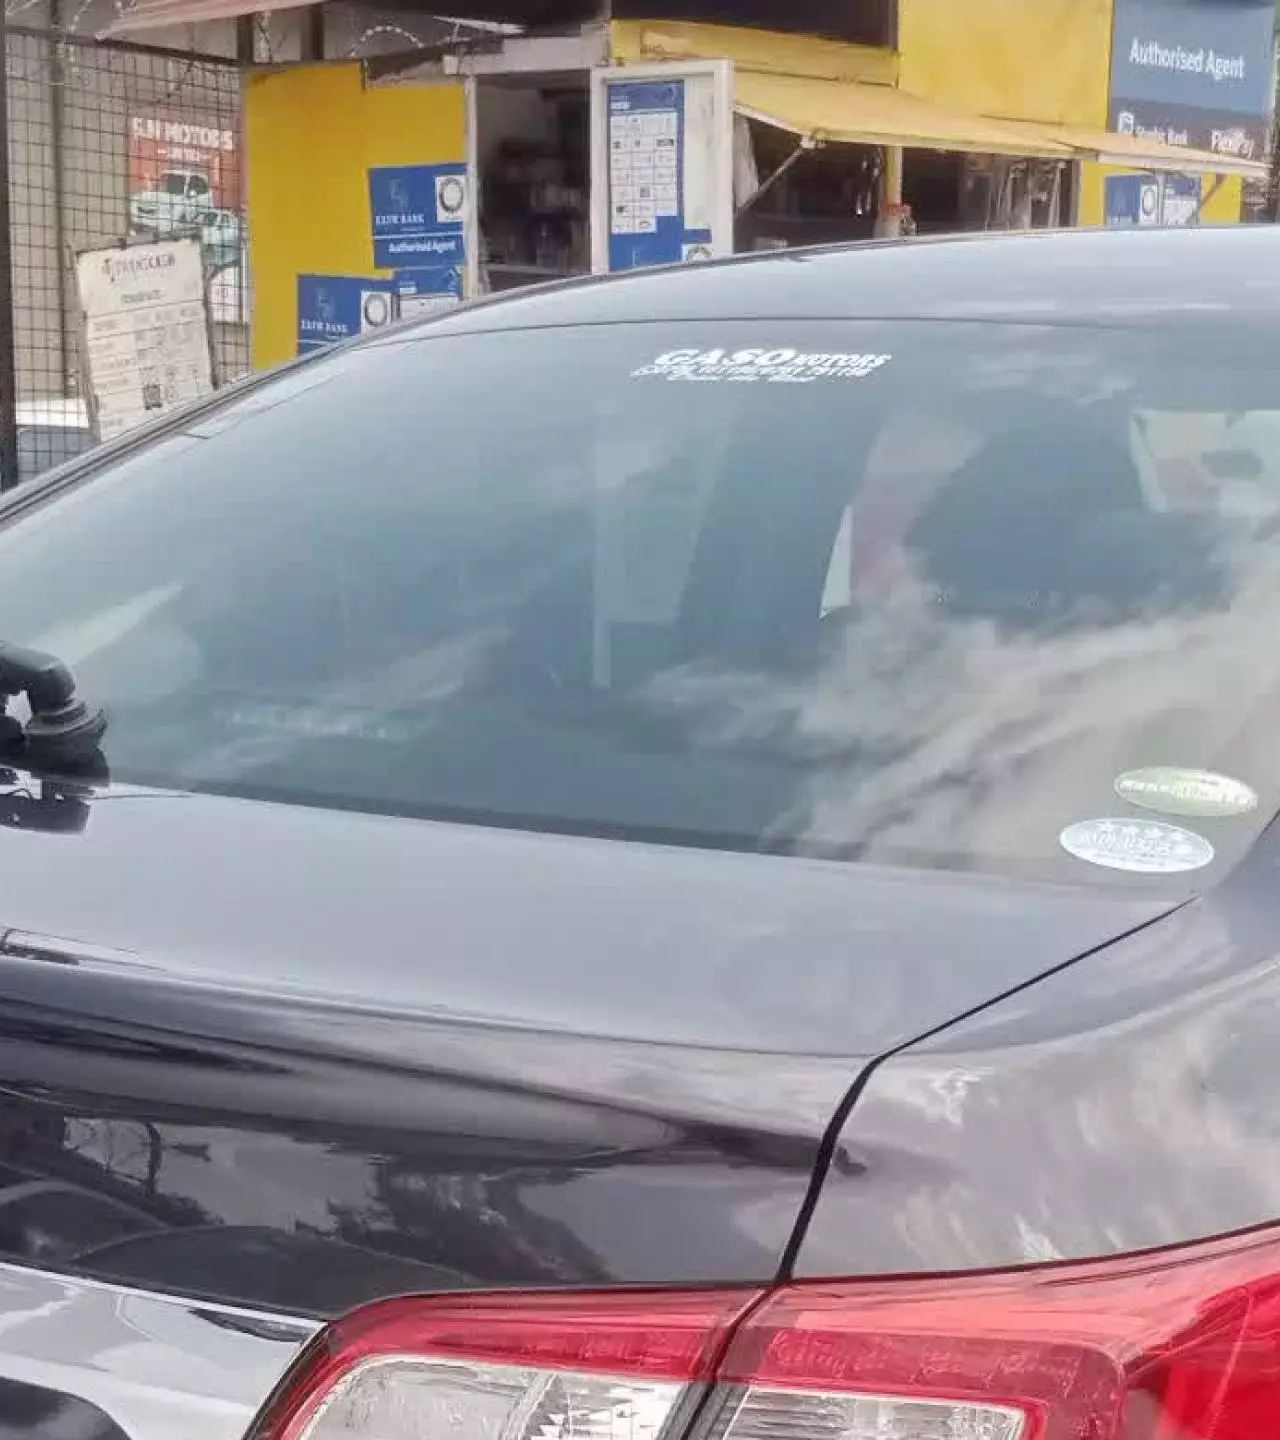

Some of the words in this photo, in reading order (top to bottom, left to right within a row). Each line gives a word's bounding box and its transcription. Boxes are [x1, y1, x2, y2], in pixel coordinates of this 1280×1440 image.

[1129, 37, 1204, 73] Authorised
[1204, 50, 1246, 80] Agent
[401, 214, 424, 224] BANK
